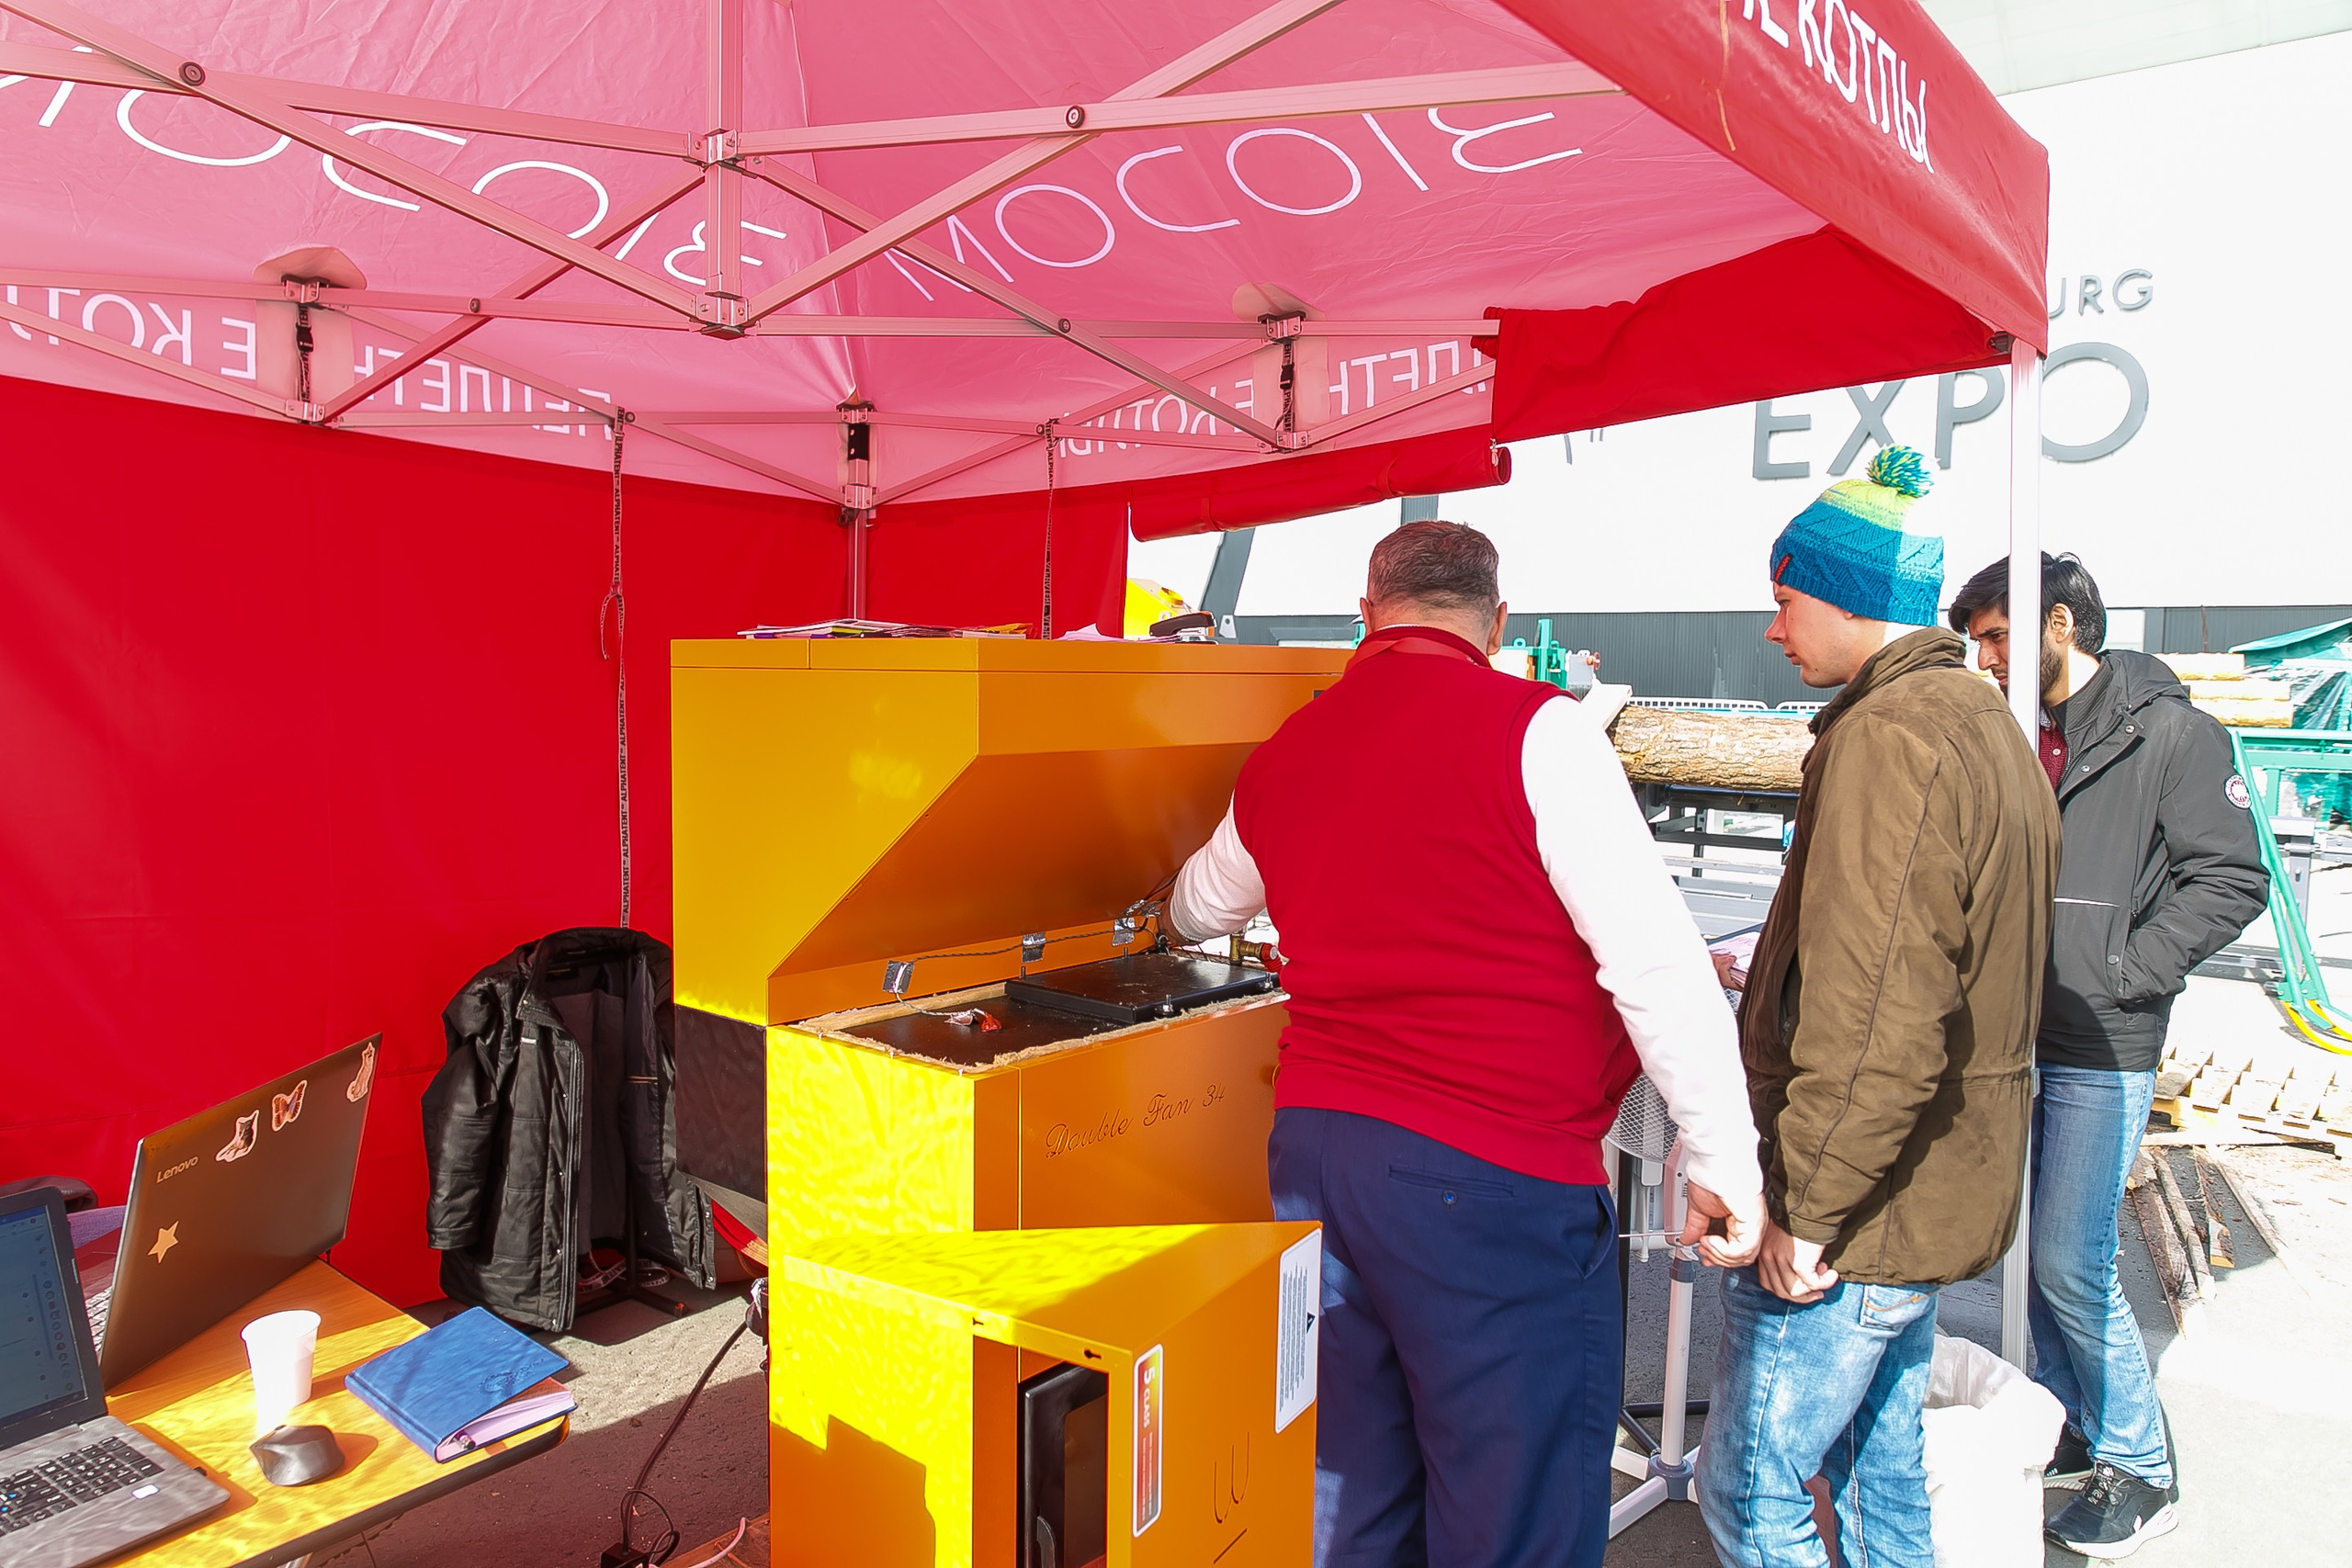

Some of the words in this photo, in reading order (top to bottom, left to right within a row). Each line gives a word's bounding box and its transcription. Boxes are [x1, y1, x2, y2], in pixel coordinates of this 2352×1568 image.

[1798, 0, 1934, 174] КОТЛЫ
[2049, 268, 2154, 320] URG
[1753, 342, 2150, 480] EXPO
[1046, 1108, 1135, 1158] Double
[1143, 1092, 1195, 1127] Fan
[1202, 1082, 1227, 1108] 34
[156, 1156, 198, 1184] Lenovo
[1143, 1366, 1156, 1385] 5
[1142, 1388, 1151, 1428] CLASS
